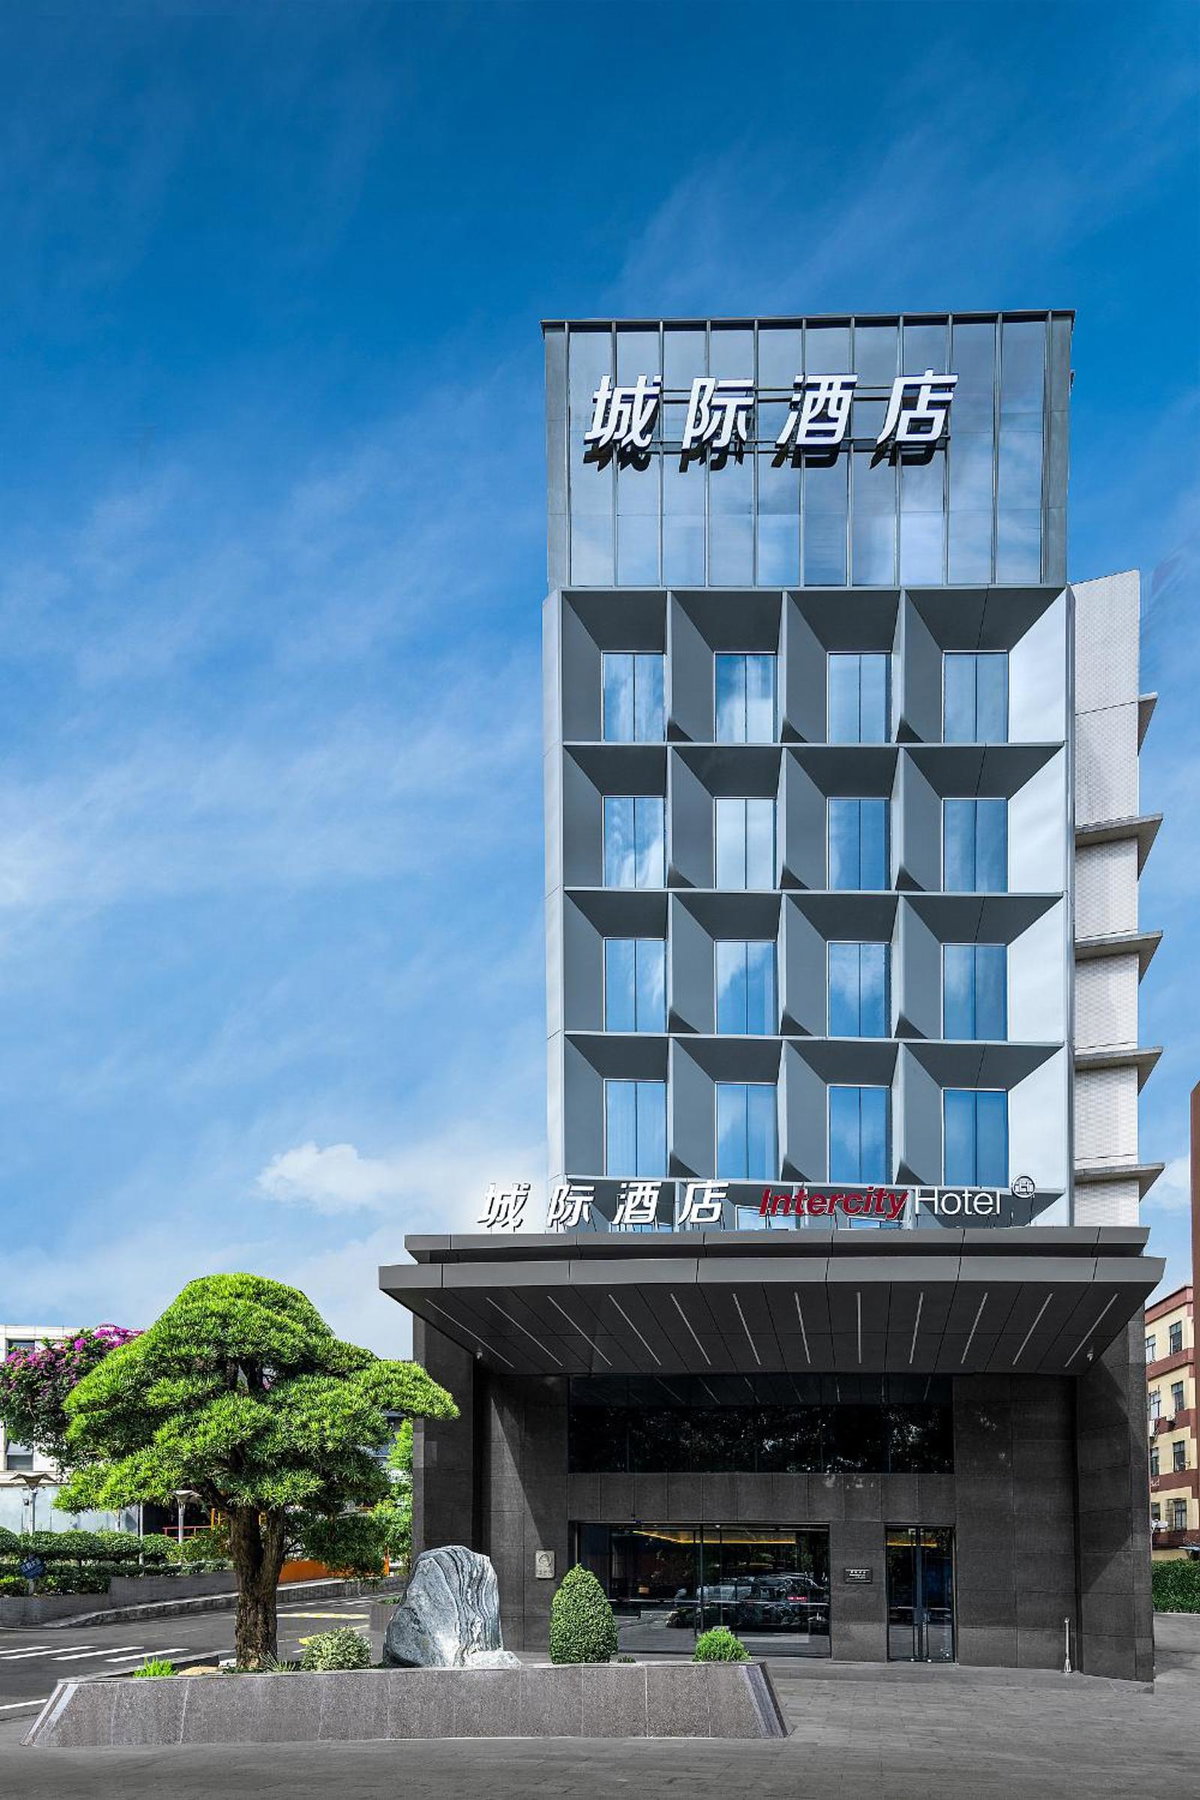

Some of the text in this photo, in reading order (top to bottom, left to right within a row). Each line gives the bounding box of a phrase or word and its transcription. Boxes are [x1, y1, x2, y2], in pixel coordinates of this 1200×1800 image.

[584, 368, 959, 450] 城际酒店
[477, 1179, 729, 1228] 城际酒店
